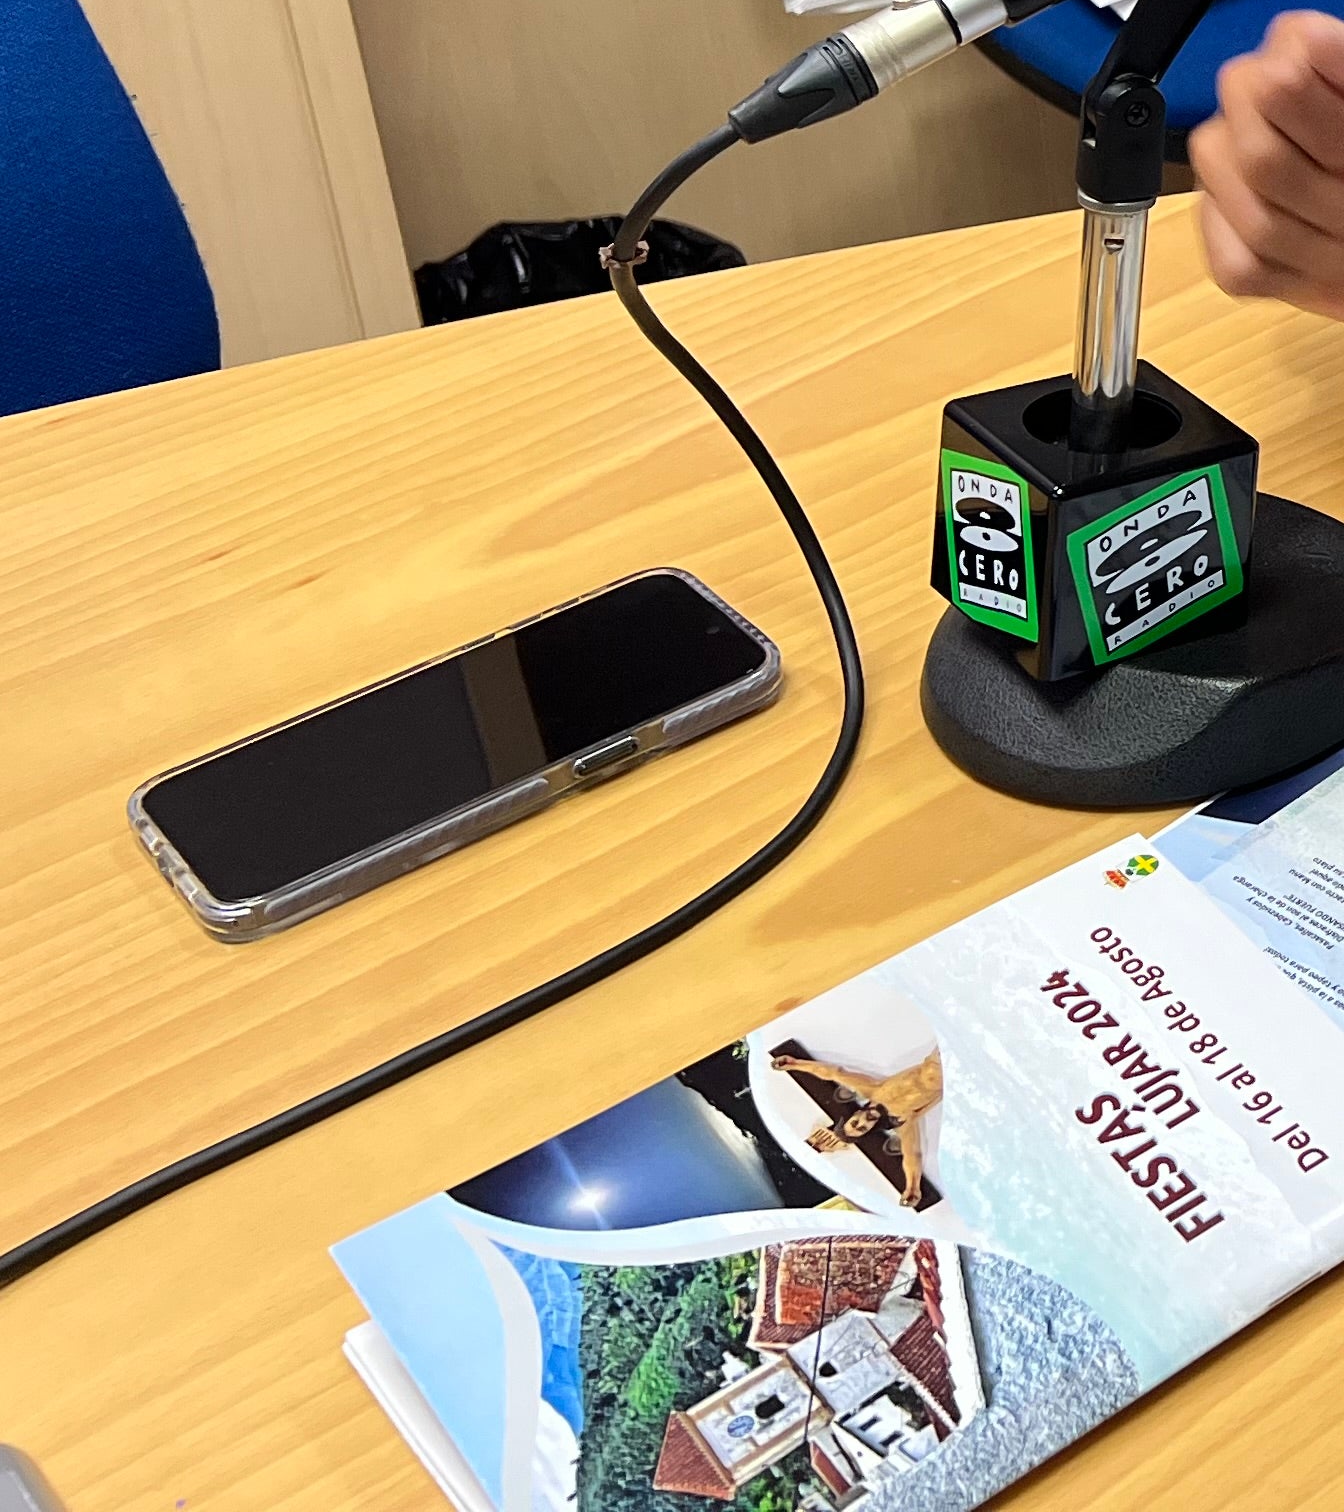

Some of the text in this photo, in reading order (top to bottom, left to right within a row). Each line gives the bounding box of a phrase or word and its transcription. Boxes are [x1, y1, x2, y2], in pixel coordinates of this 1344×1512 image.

[958, 475, 1013, 503] ONDA
[1099, 490, 1197, 553] ONDA
[959, 549, 1019, 591] CERO
[963, 589, 1023, 613] RADIO
[1105, 554, 1209, 625] CERO
[1114, 569, 1215, 646] RADIO
[1040, 969, 1200, 1129] LÚJAR 2024
[1091, 927, 1329, 1172] Del 16 al 18 de Agosto
[1075, 1094, 1224, 1242] FIESTAS
